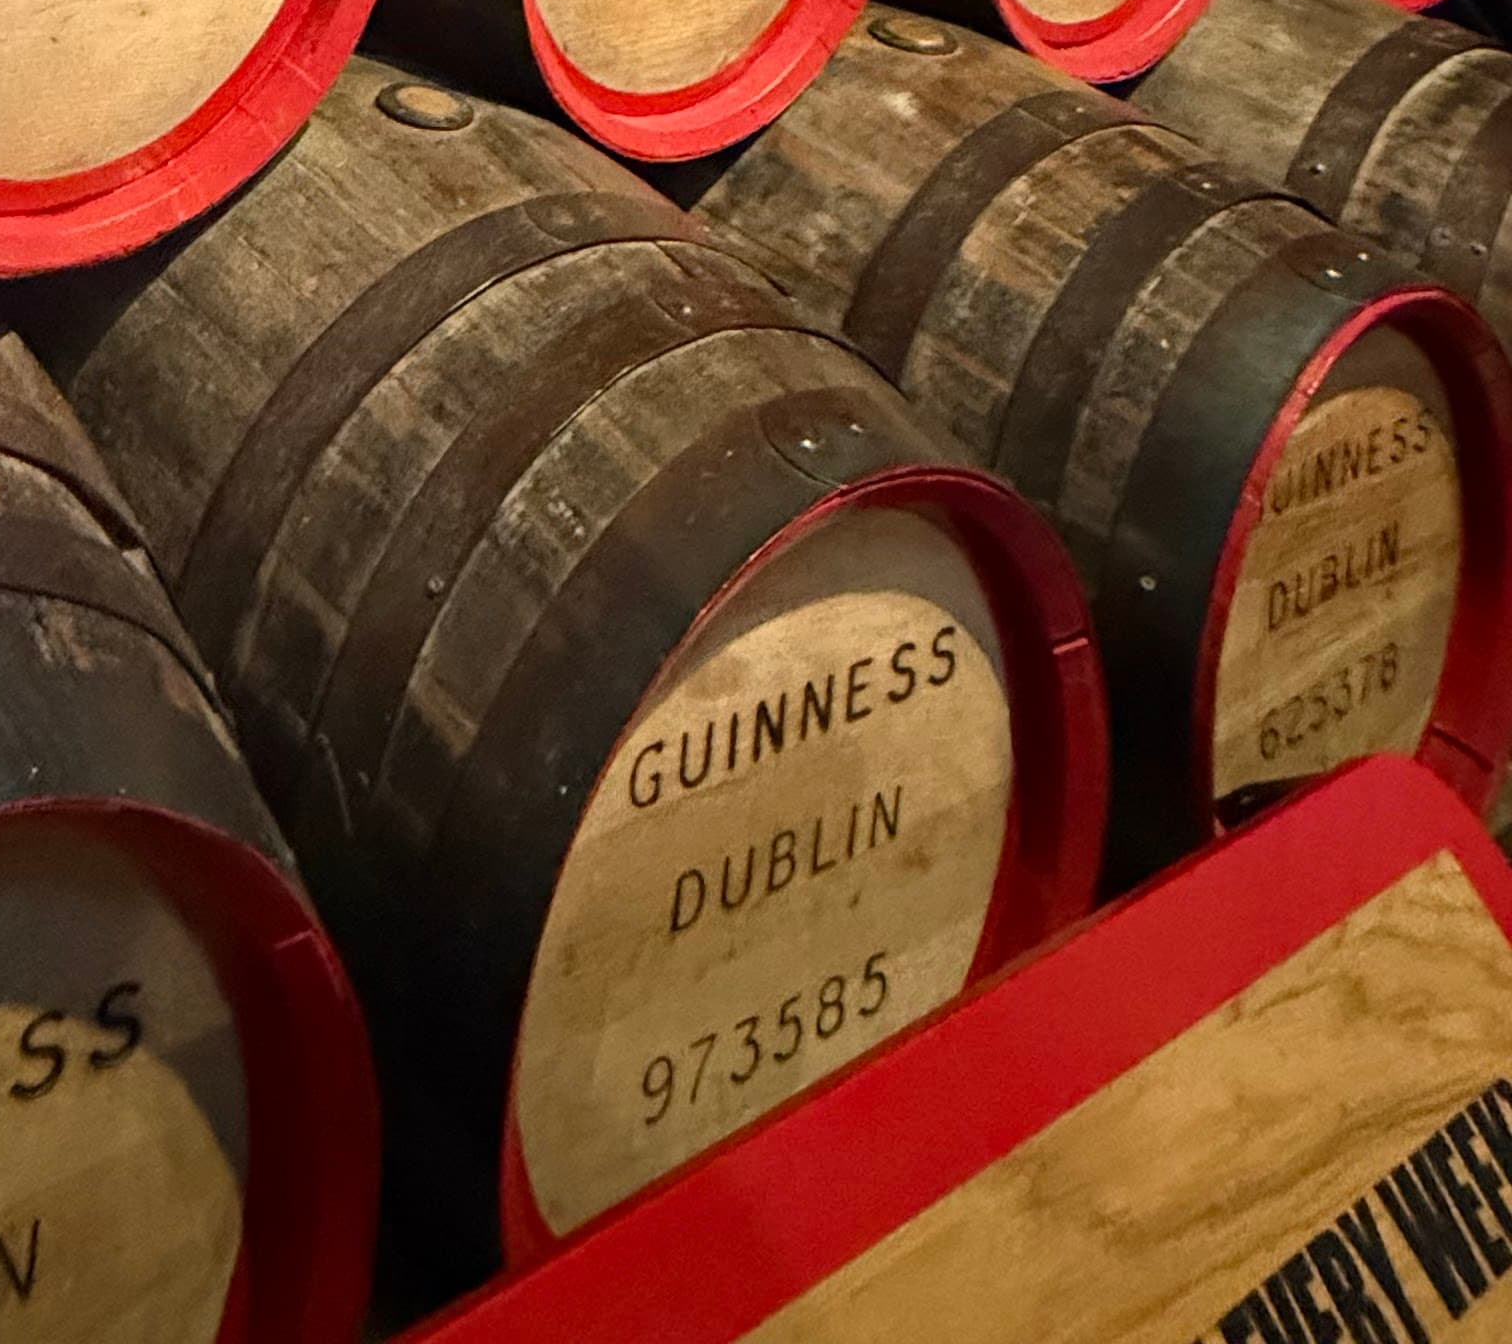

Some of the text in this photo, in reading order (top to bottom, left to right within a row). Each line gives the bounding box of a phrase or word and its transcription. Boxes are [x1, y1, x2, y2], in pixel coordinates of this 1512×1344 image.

[1268, 407, 1433, 515] UINNESS
[1266, 519, 1402, 634] DUBLIN
[628, 625, 960, 809] GUINNESS
[1258, 641, 1400, 761] 625378
[667, 784, 904, 936] DUBLIN
[641, 950, 892, 1127] 973585
